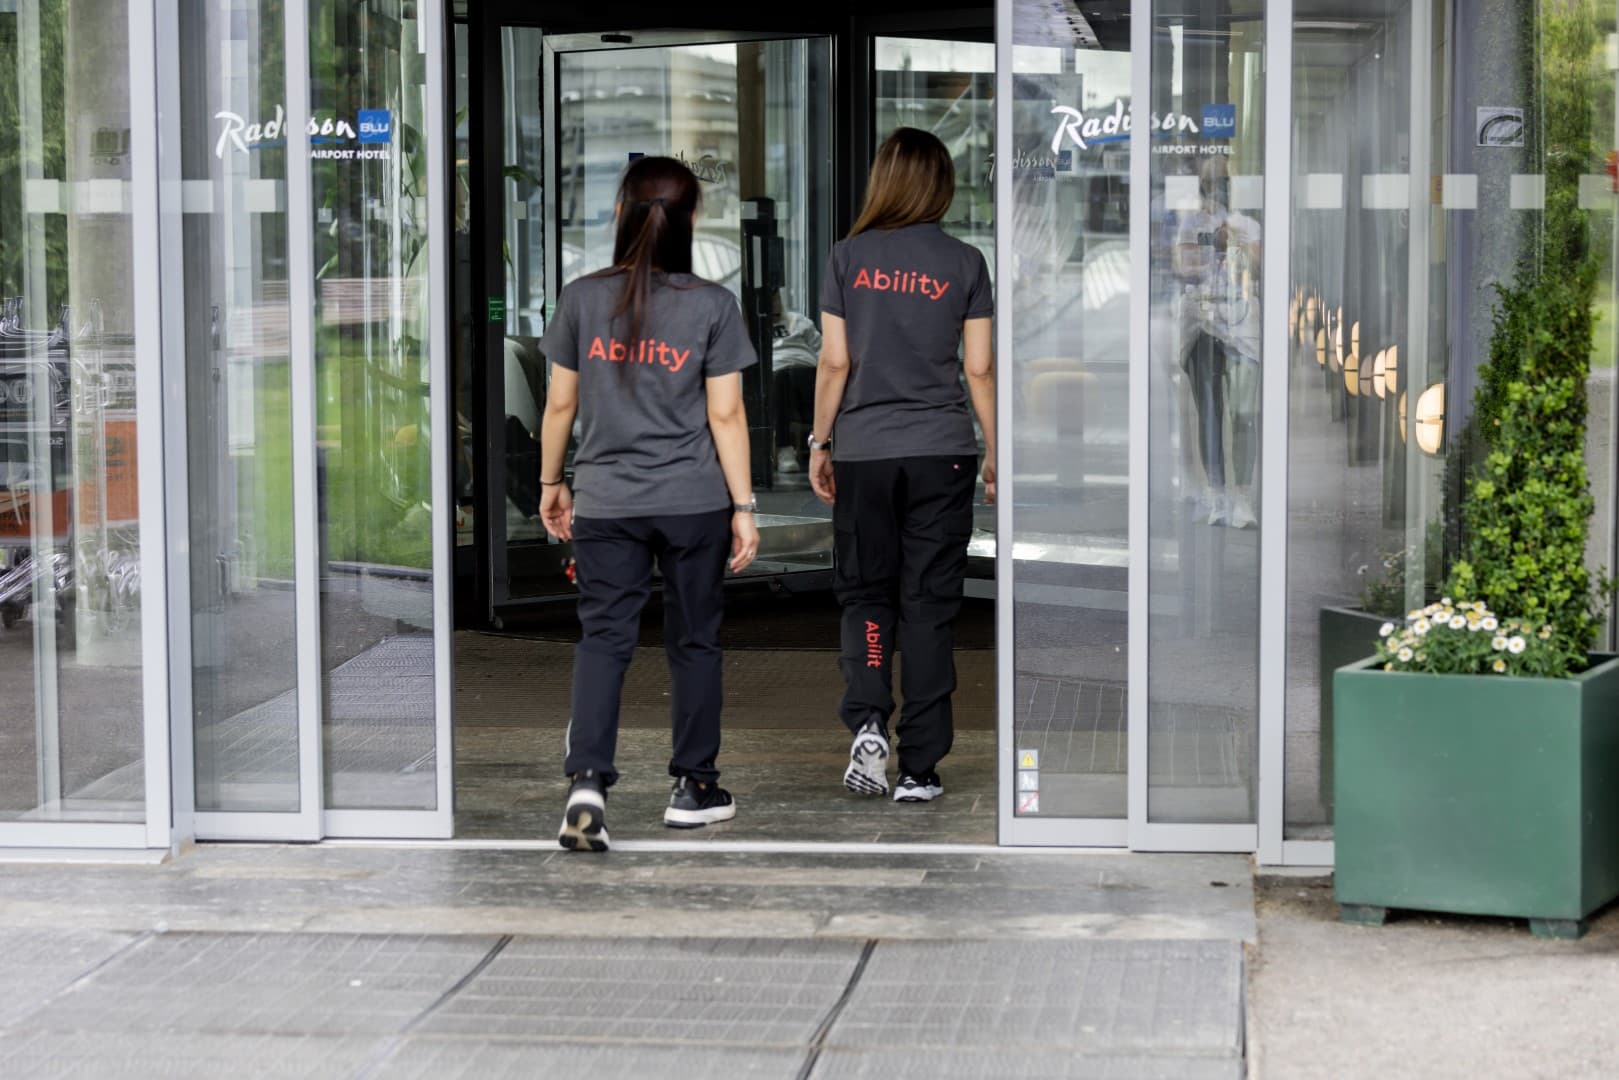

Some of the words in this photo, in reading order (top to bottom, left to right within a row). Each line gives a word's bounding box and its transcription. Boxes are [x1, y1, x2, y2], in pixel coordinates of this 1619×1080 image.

[1203, 117, 1234, 127] BLU
[359, 122, 389, 133] BLU
[1152, 145, 1196, 154] AIRPORT
[1199, 145, 1235, 154] HOTEL
[311, 150, 354, 159] AIRPORT
[356, 150, 391, 160] HOTEL
[852, 267, 950, 300] Ability
[587, 336, 692, 372] Ability
